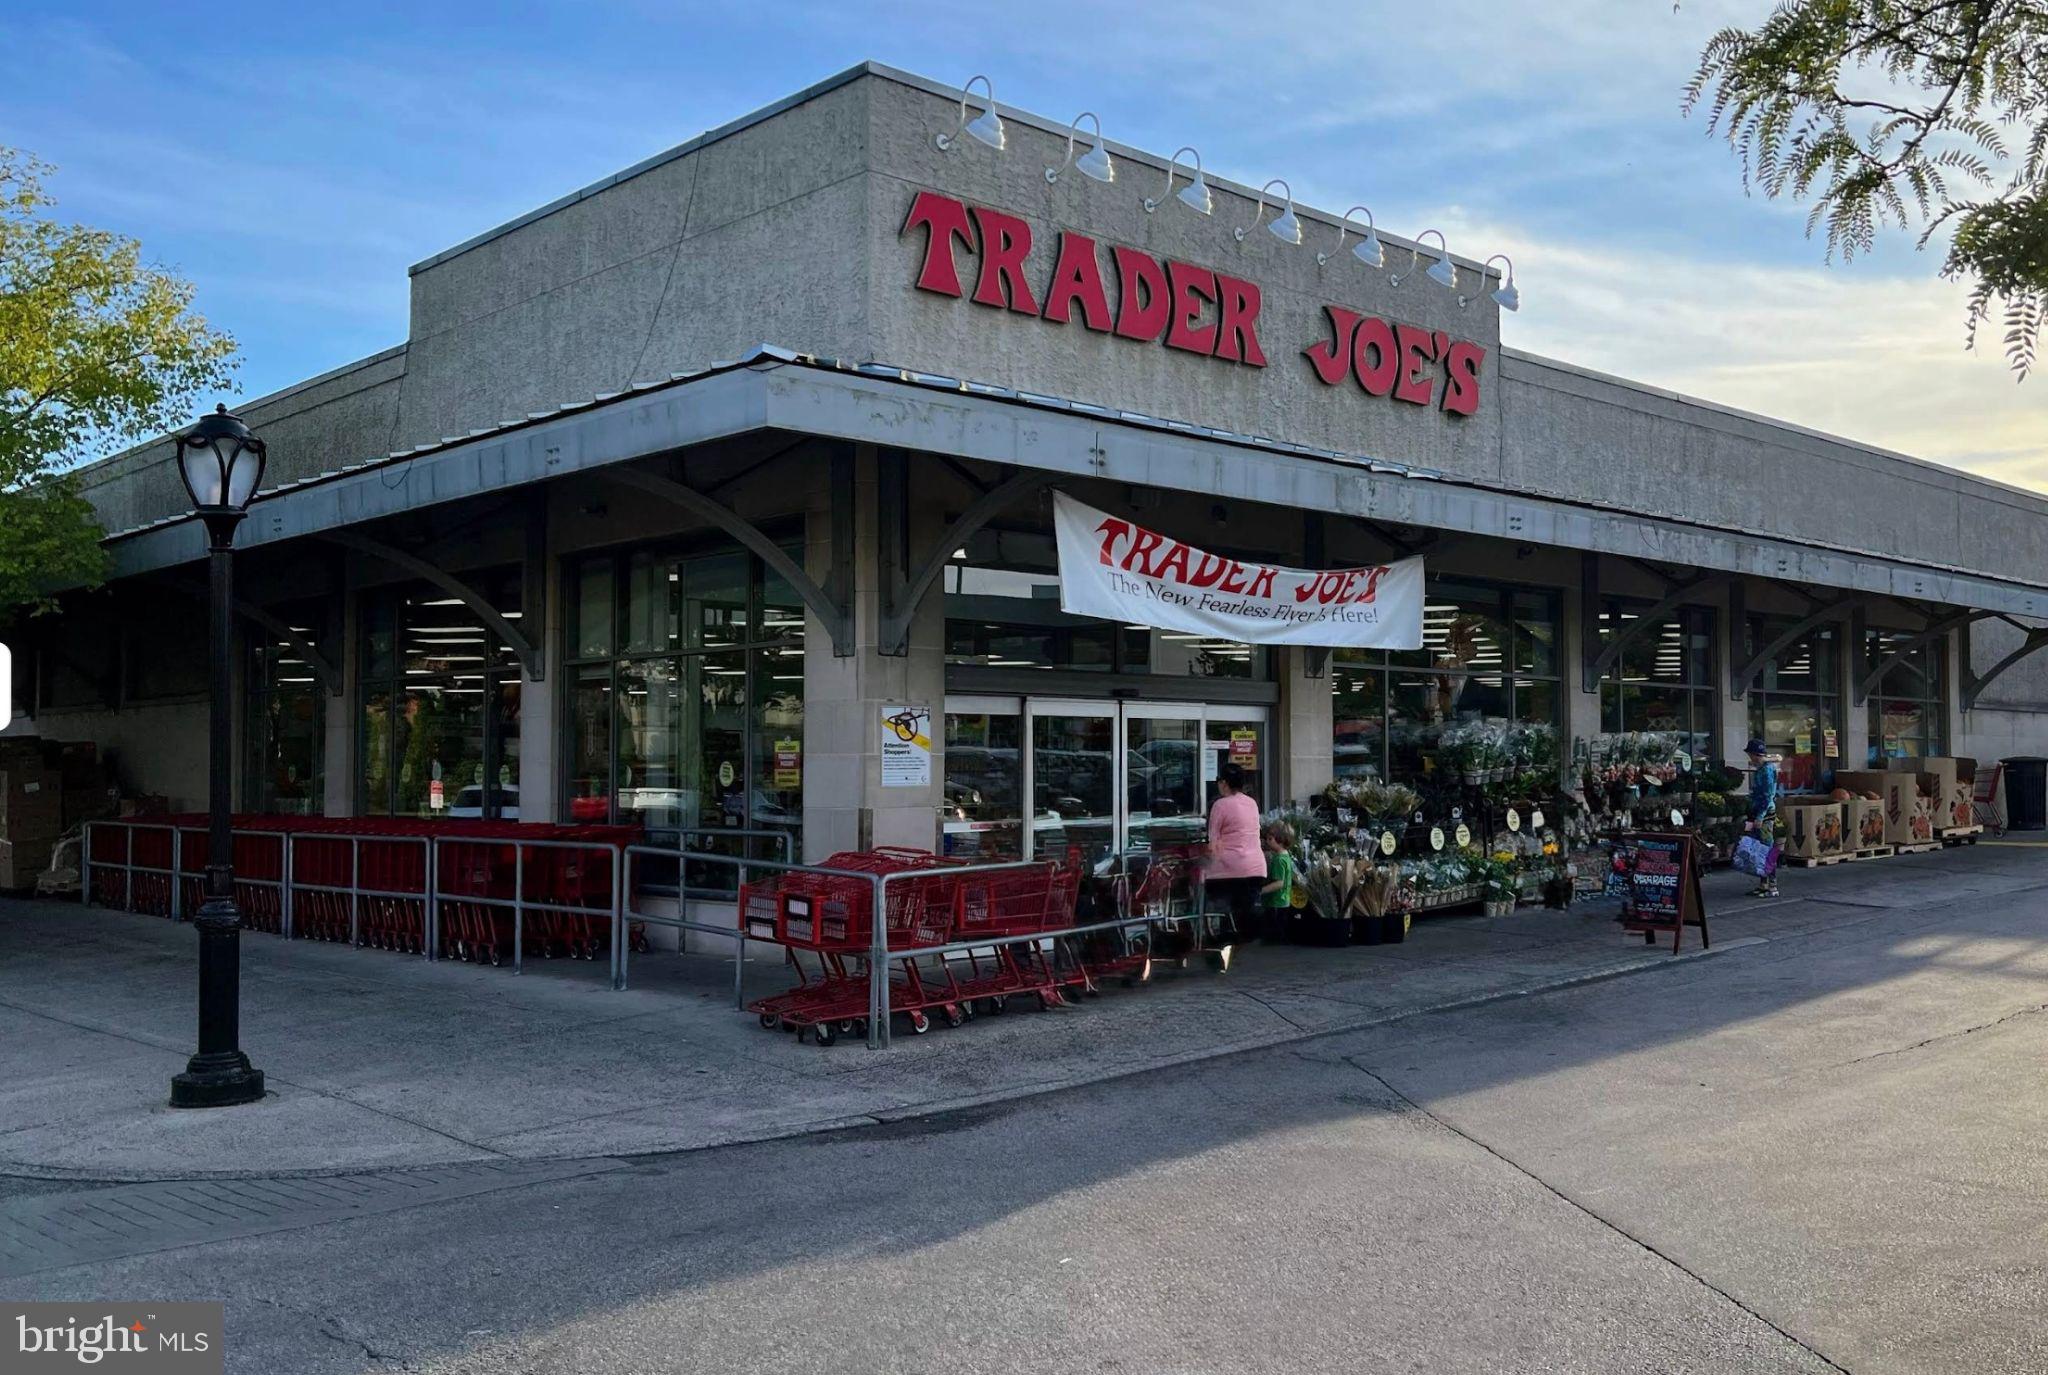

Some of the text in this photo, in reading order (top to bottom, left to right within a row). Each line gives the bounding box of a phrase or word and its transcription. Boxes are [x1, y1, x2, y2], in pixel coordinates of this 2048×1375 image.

[901, 191, 1486, 416] TRADER JOE'S
[1095, 518, 1279, 598] TRADER
[1107, 572, 1140, 596] The
[1146, 581, 1194, 606] New
[1197, 593, 1271, 617] Fearless
[1272, 604, 1316, 627] Flyer
[1331, 606, 1379, 624] Here!
